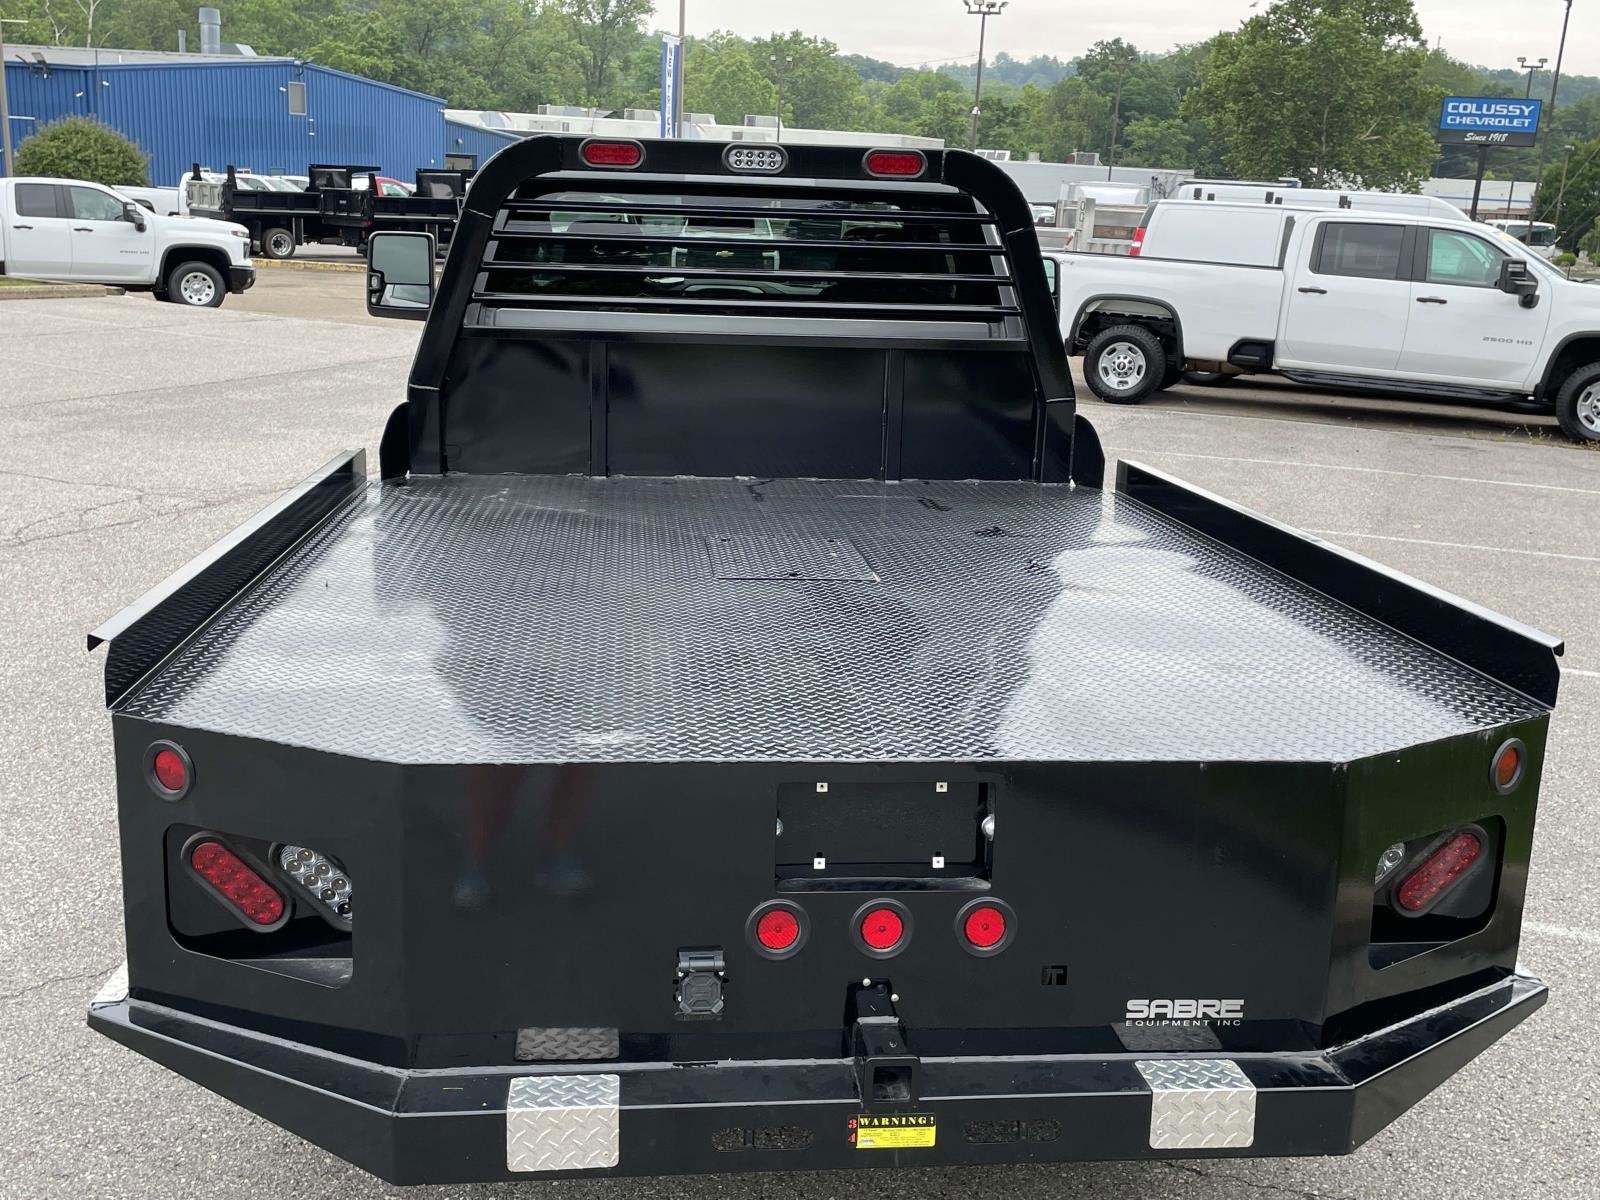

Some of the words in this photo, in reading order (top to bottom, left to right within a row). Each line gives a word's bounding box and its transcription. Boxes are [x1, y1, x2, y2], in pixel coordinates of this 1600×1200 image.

[1447, 102, 1535, 116] COLUSSY
[1446, 115, 1532, 127] CHEVROLET
[1464, 132, 1487, 141] Since
[1488, 133, 1509, 142] 1918
[1482, 336, 1513, 344] 2500
[1125, 999, 1245, 1019] SABRE
[1125, 1019, 1211, 1027] EQUIPMENT
